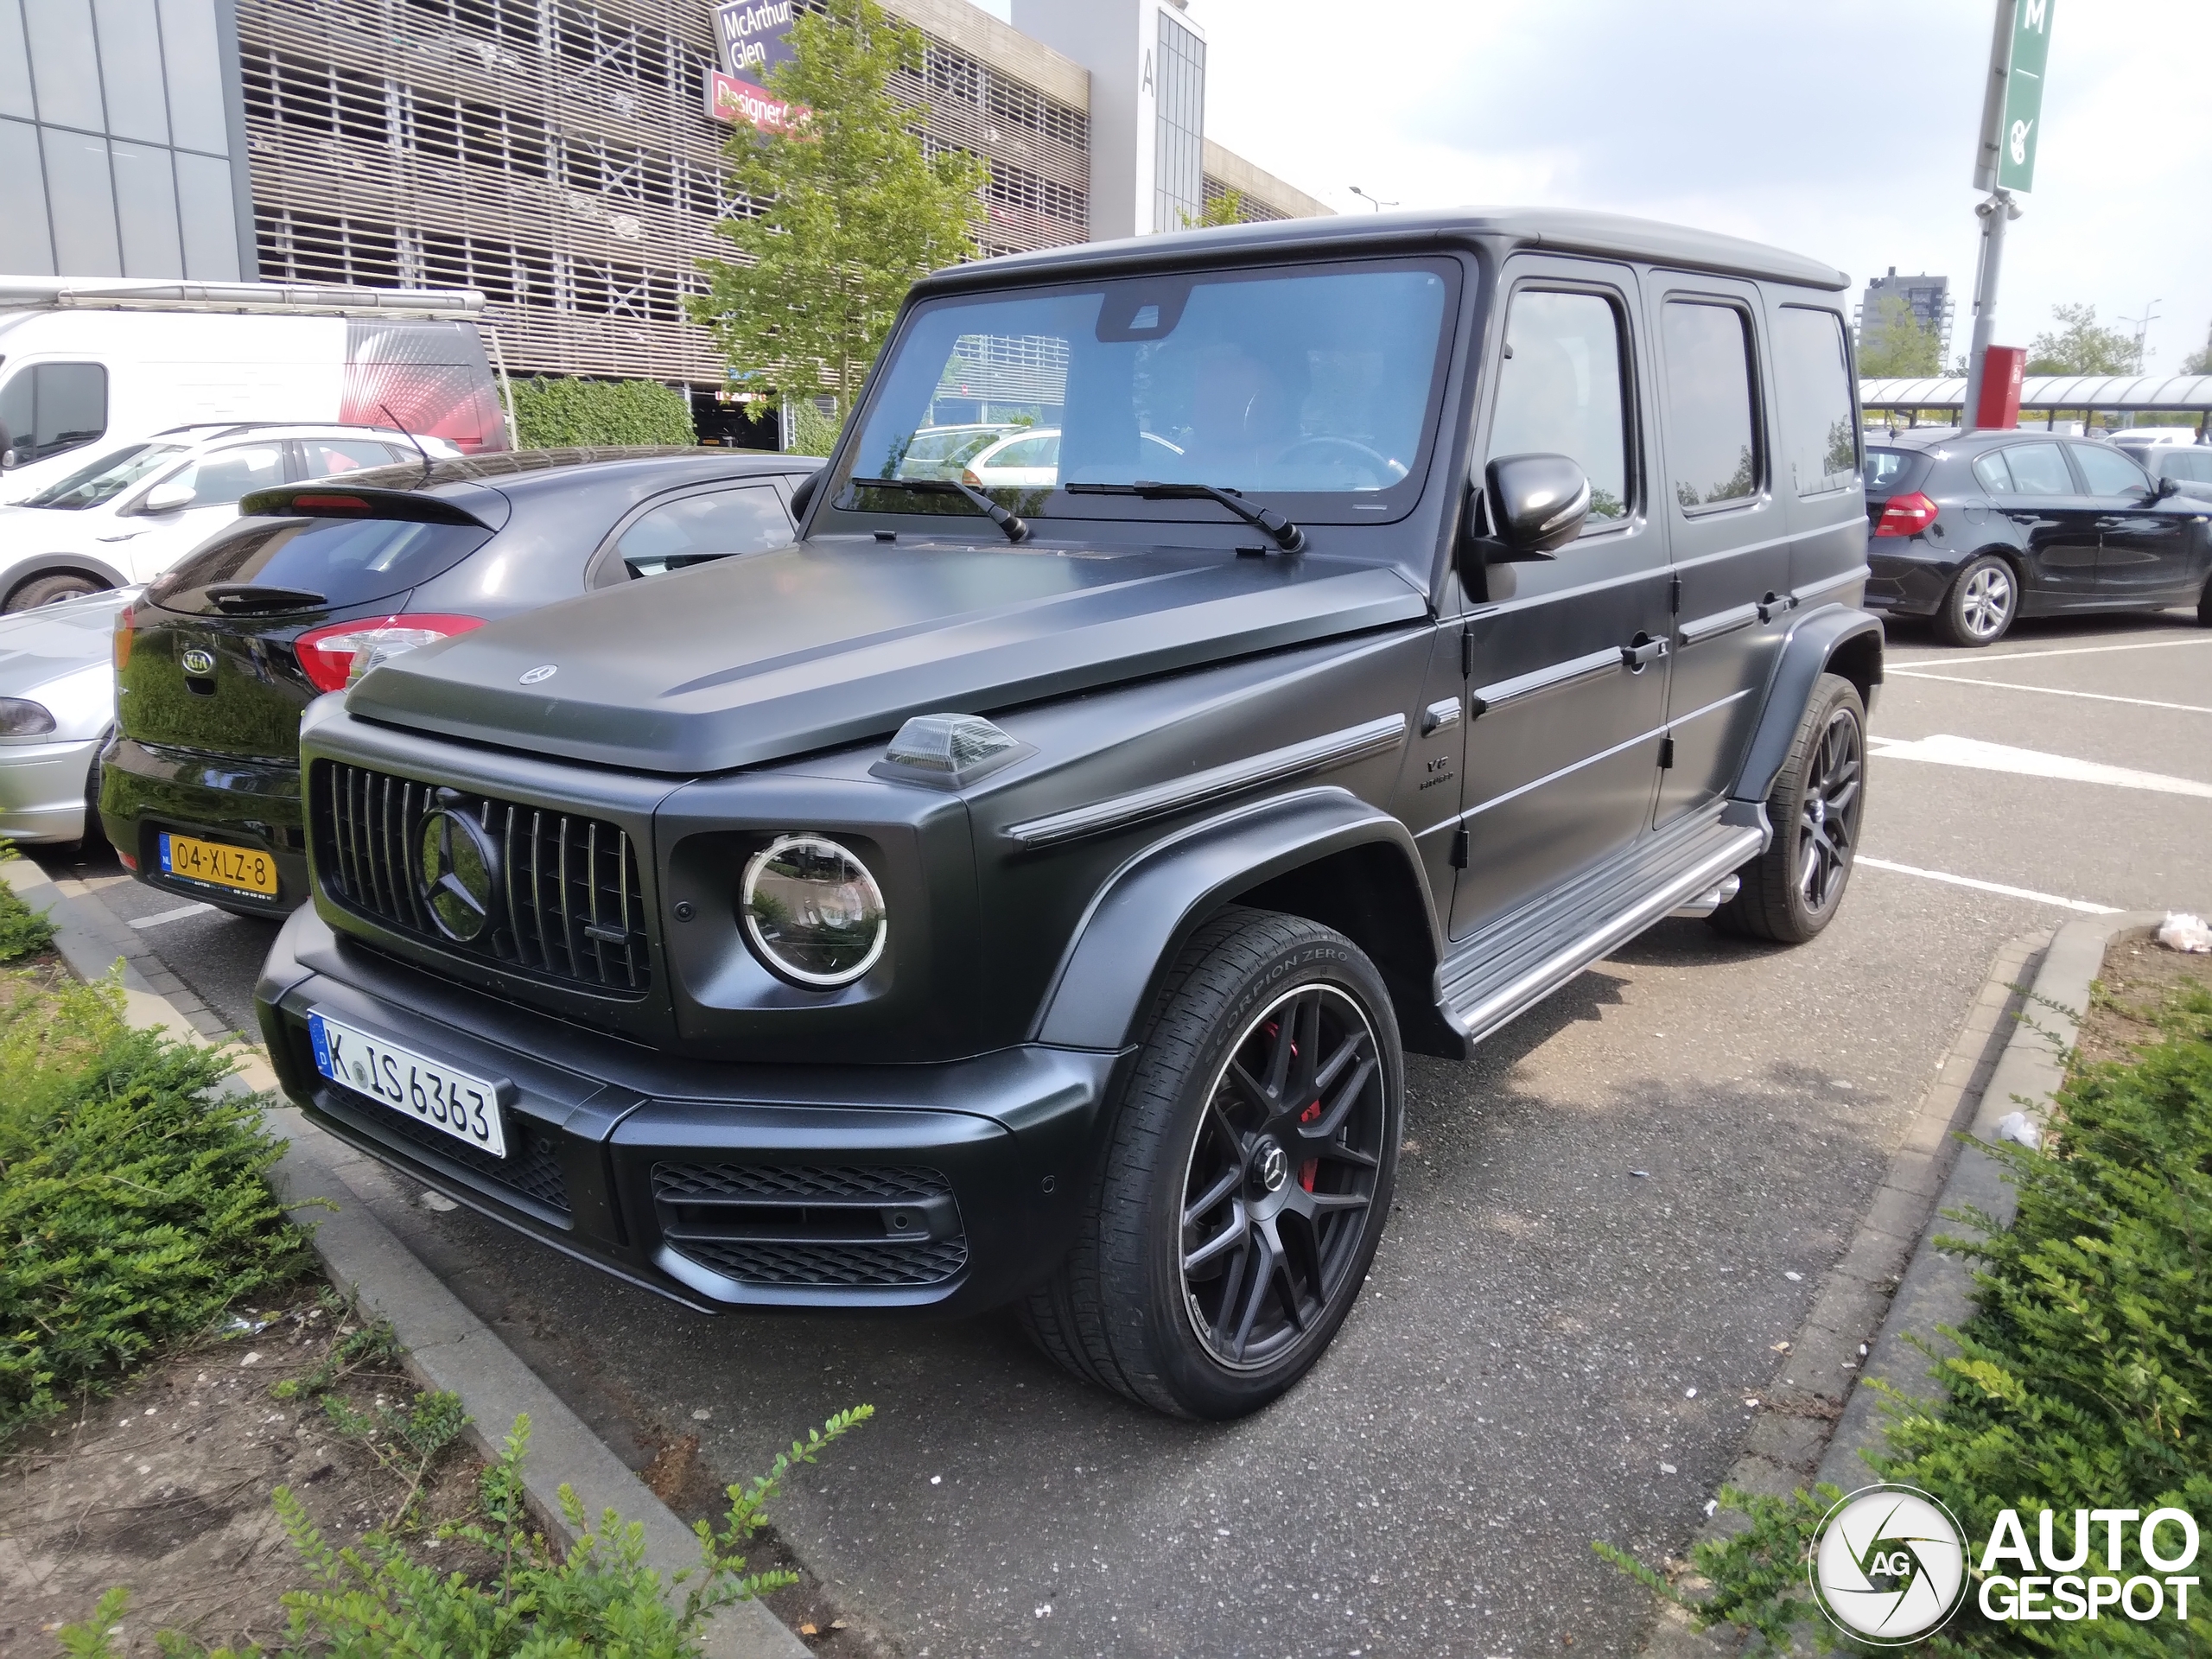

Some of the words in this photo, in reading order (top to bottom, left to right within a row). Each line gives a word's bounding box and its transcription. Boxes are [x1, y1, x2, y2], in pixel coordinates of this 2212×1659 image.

[723, 0, 789, 41] McArthur
[2024, 0, 2046, 35] M
[731, 39, 766, 69] Glen
[1142, 48, 1154, 98] A
[186, 653, 207, 670] KIA
[177, 842, 266, 886] 04-XLZ-8
[1205, 955, 1297, 1066] SCORPION
[1301, 948, 1349, 963] ZERO
[319, 1051, 327, 1065] D
